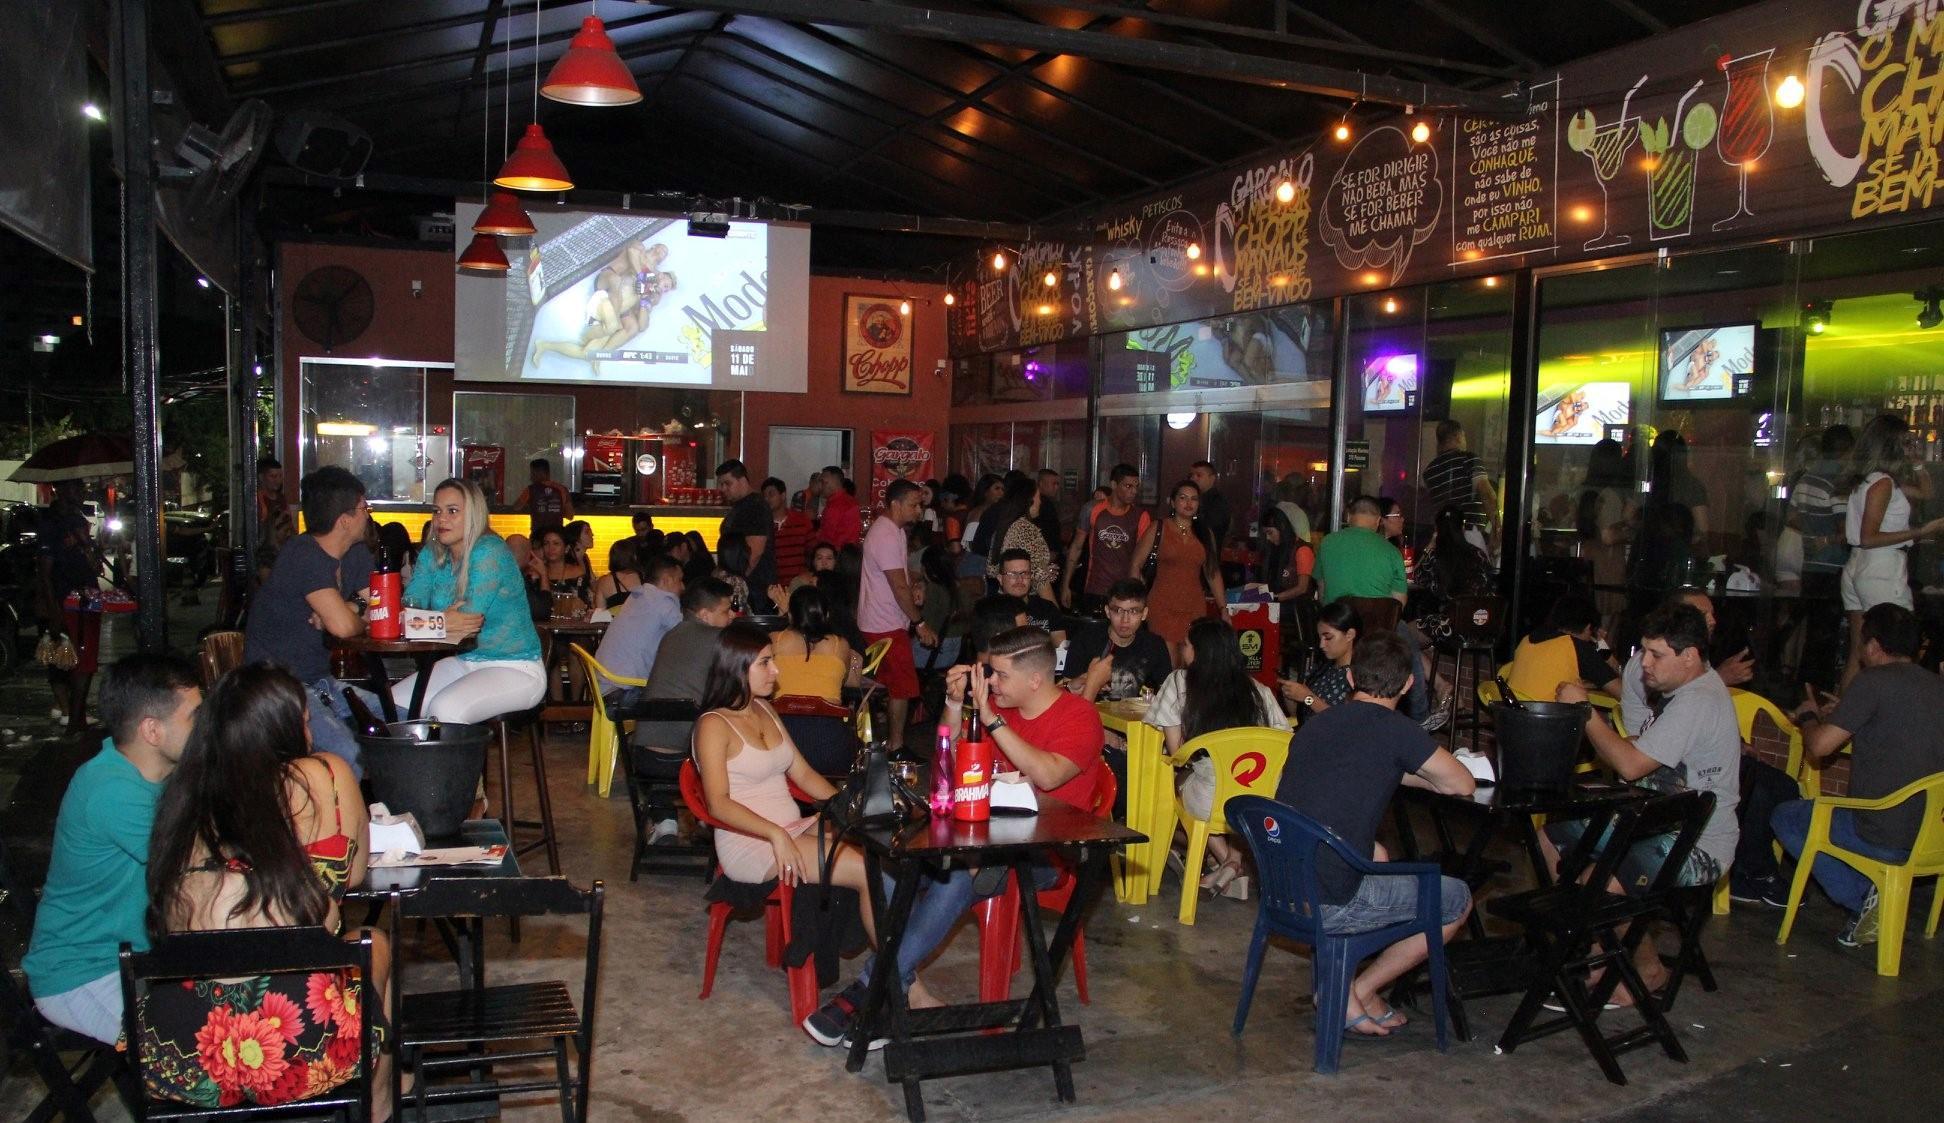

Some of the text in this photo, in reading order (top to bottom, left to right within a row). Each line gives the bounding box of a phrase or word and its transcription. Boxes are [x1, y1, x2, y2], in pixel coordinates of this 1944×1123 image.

[1470, 131, 1487, 147] são
[1489, 129, 1501, 143] as
[1472, 135, 1537, 160] Você não me
[1341, 152, 1429, 190] SE FOR DIRIGIR
[1399, 171, 1427, 194] MAS
[1474, 166, 1533, 190] não sabe de
[1142, 194, 1184, 220] PETISCOS
[1343, 189, 1424, 222] SE FOR BEBER
[1464, 191, 1487, 207] onde
[1489, 189, 1501, 201] eu
[1473, 196, 1533, 223] por isso não
[1349, 208, 1418, 237] ME CHAMA!
[1466, 207, 1541, 236] me CAMPARI
[1455, 239, 1476, 252] com
[1477, 231, 1517, 252] qualquer
[731, 353, 755, 364] 11 DE
[873, 447, 931, 464] Gargalo
[428, 615, 445, 630] 59
[955, 782, 989, 803] BRAHMA
